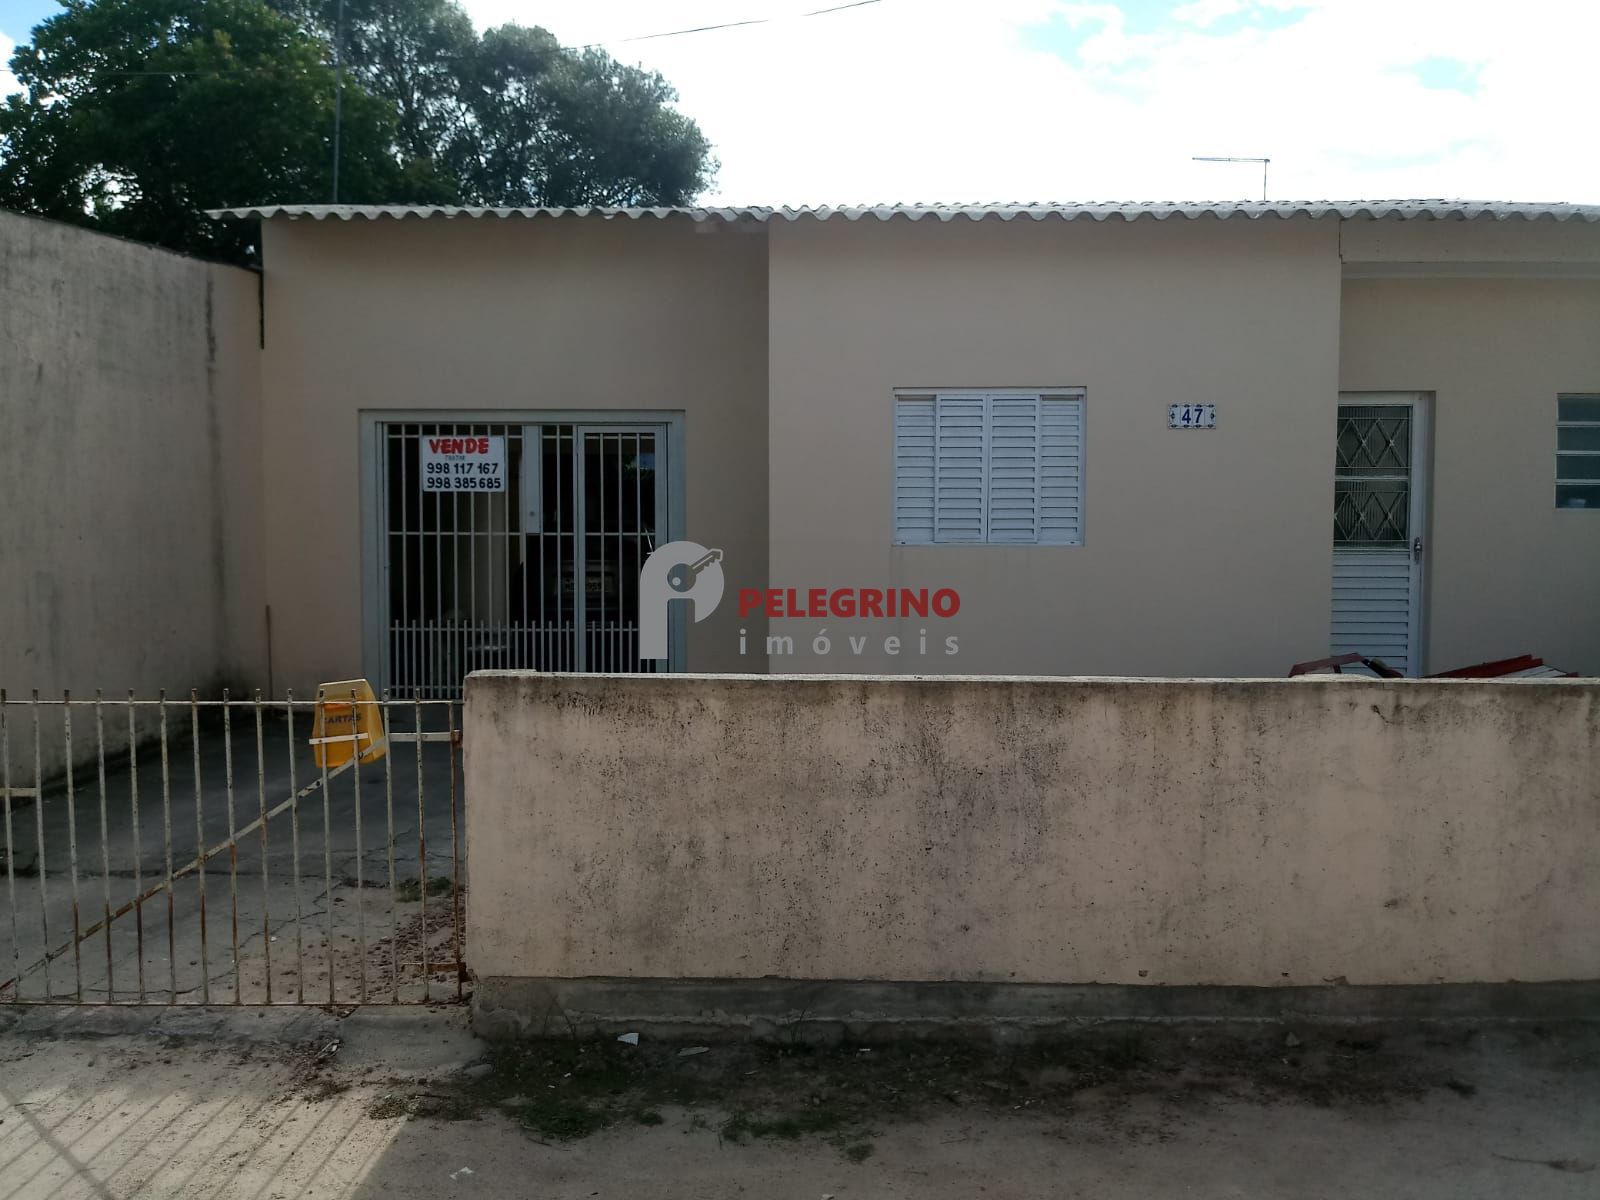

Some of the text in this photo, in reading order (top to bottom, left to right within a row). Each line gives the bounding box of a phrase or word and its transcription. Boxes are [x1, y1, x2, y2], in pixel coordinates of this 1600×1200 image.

[1181, 408, 1204, 424] 47
[429, 438, 489, 454] VENDE
[427, 463, 498, 474] 998 117 167
[427, 477, 501, 489] 998 385 685
